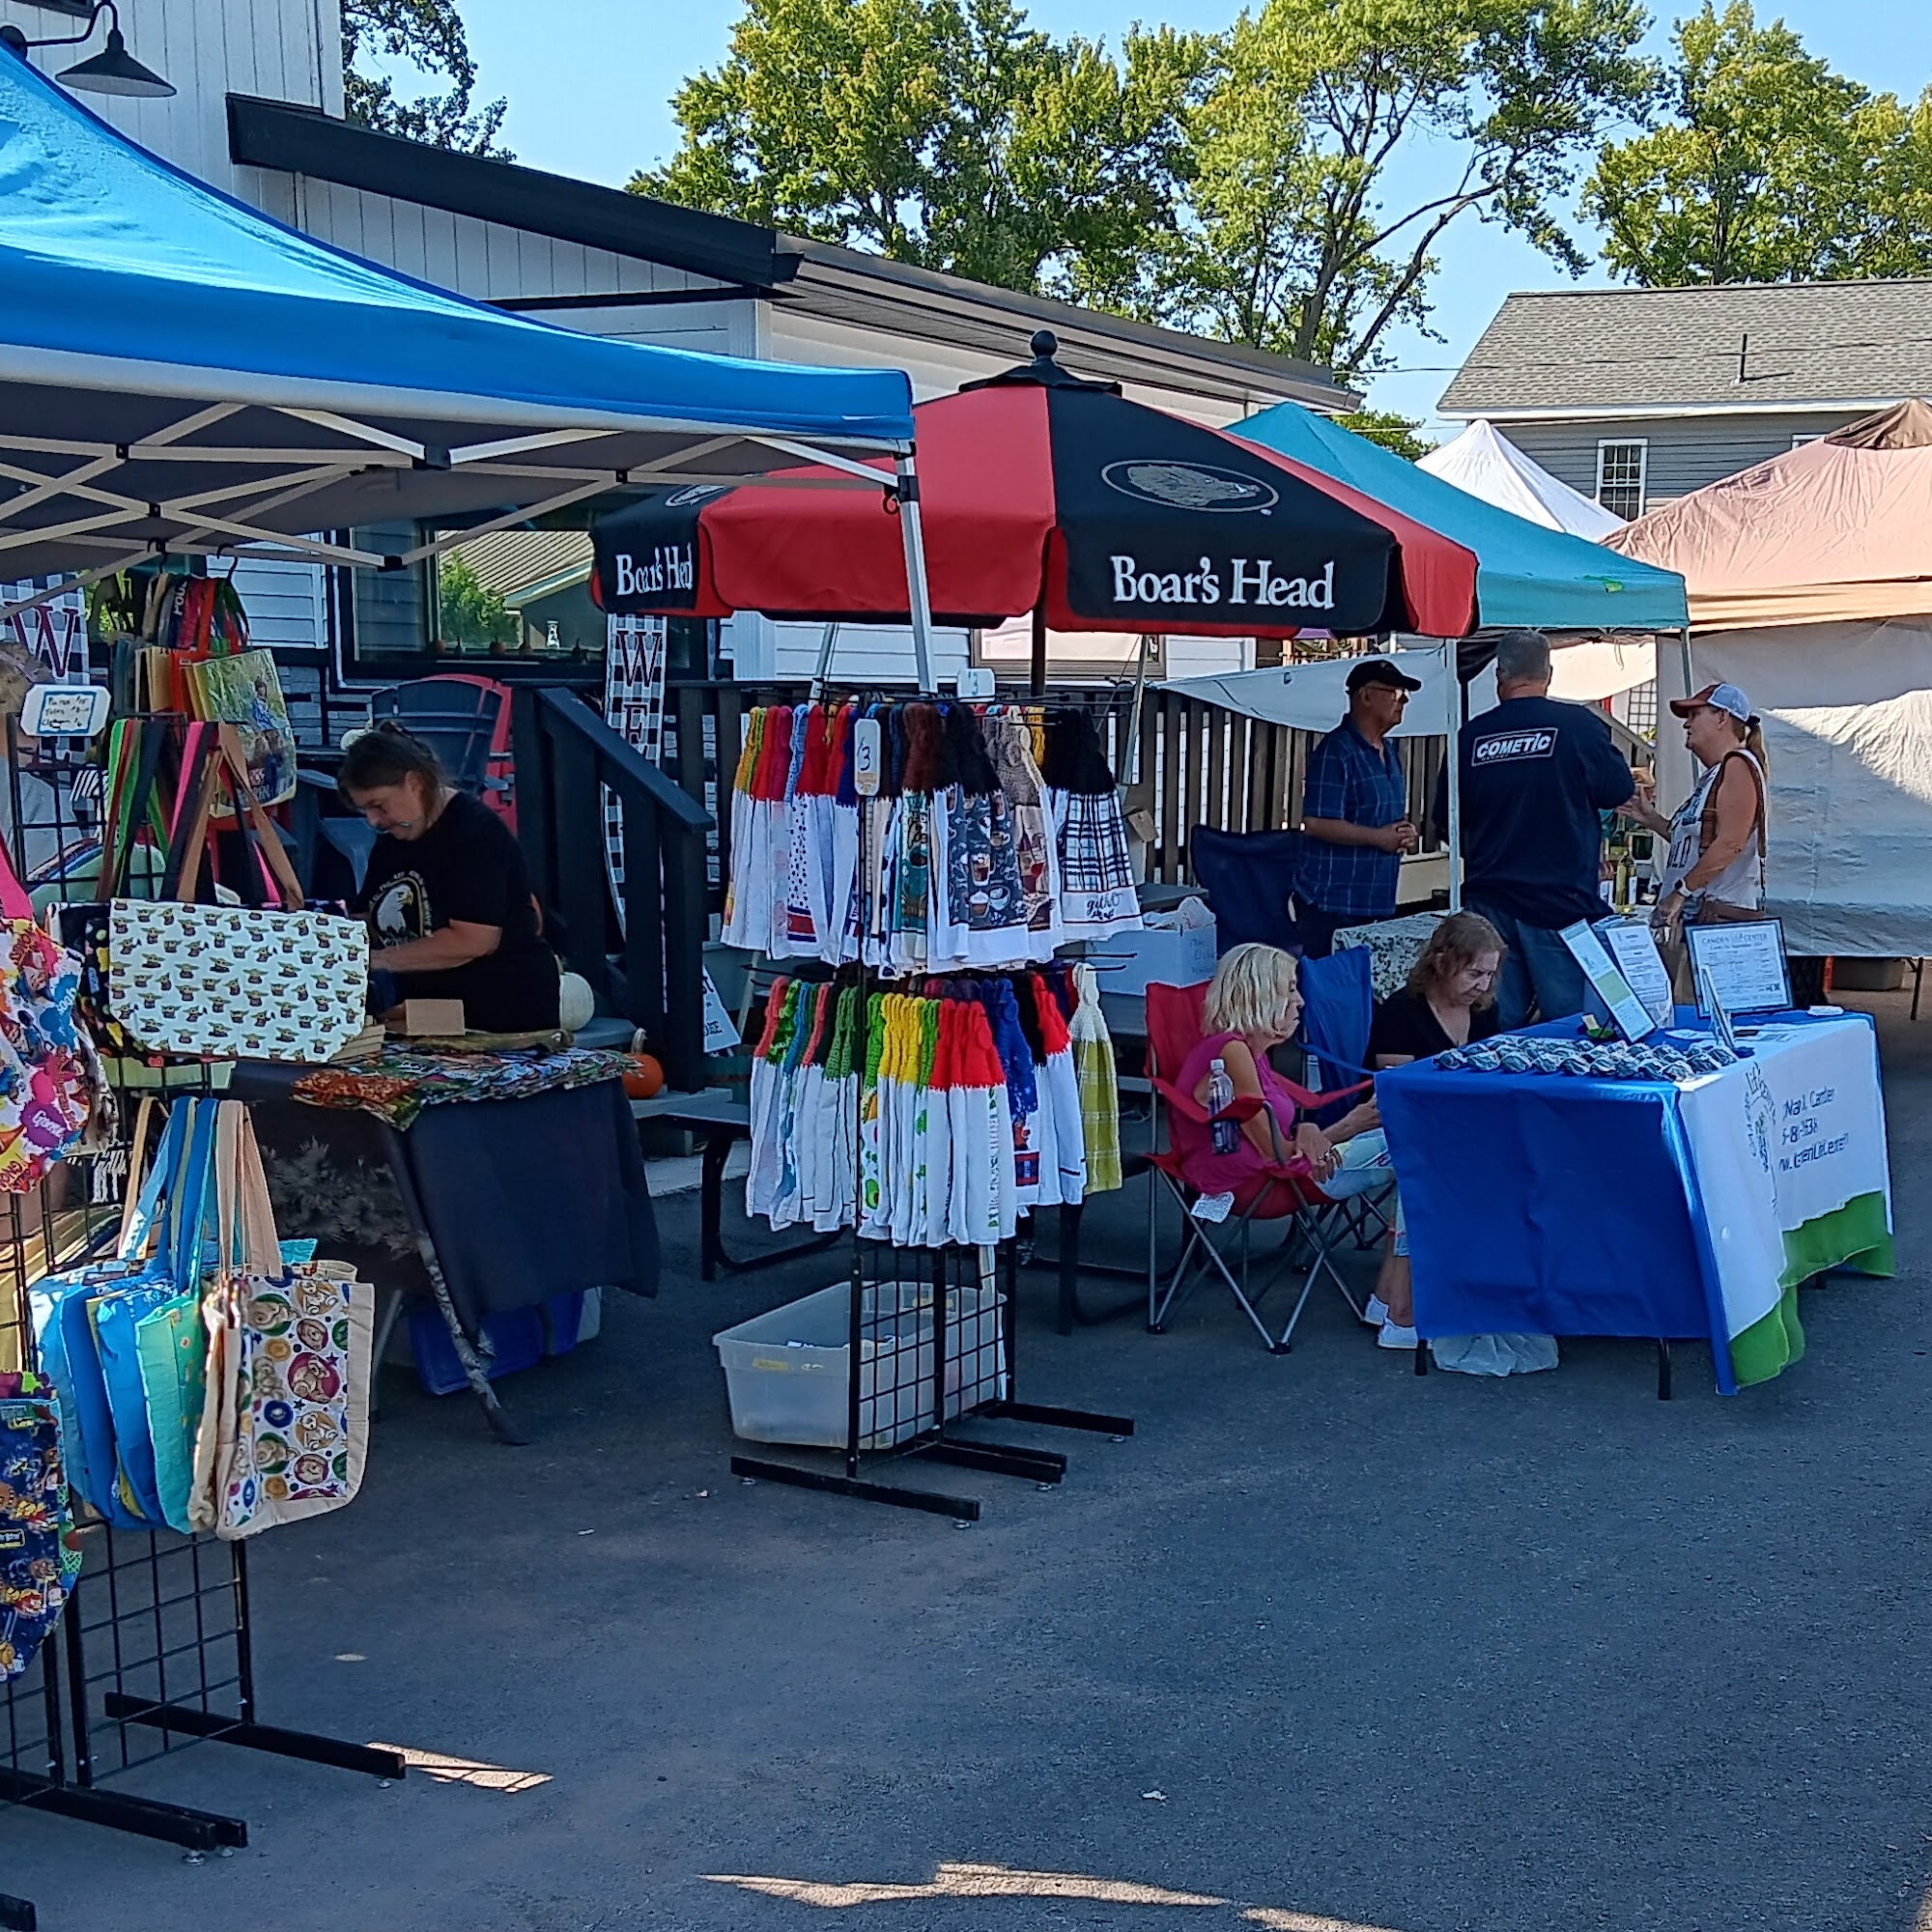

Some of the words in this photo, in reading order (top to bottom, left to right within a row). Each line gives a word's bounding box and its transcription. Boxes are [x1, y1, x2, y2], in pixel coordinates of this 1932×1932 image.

[1110, 554, 1221, 605] Boar's
[1229, 558, 1335, 611] Head
[1476, 732, 1551, 759] COMETIC
